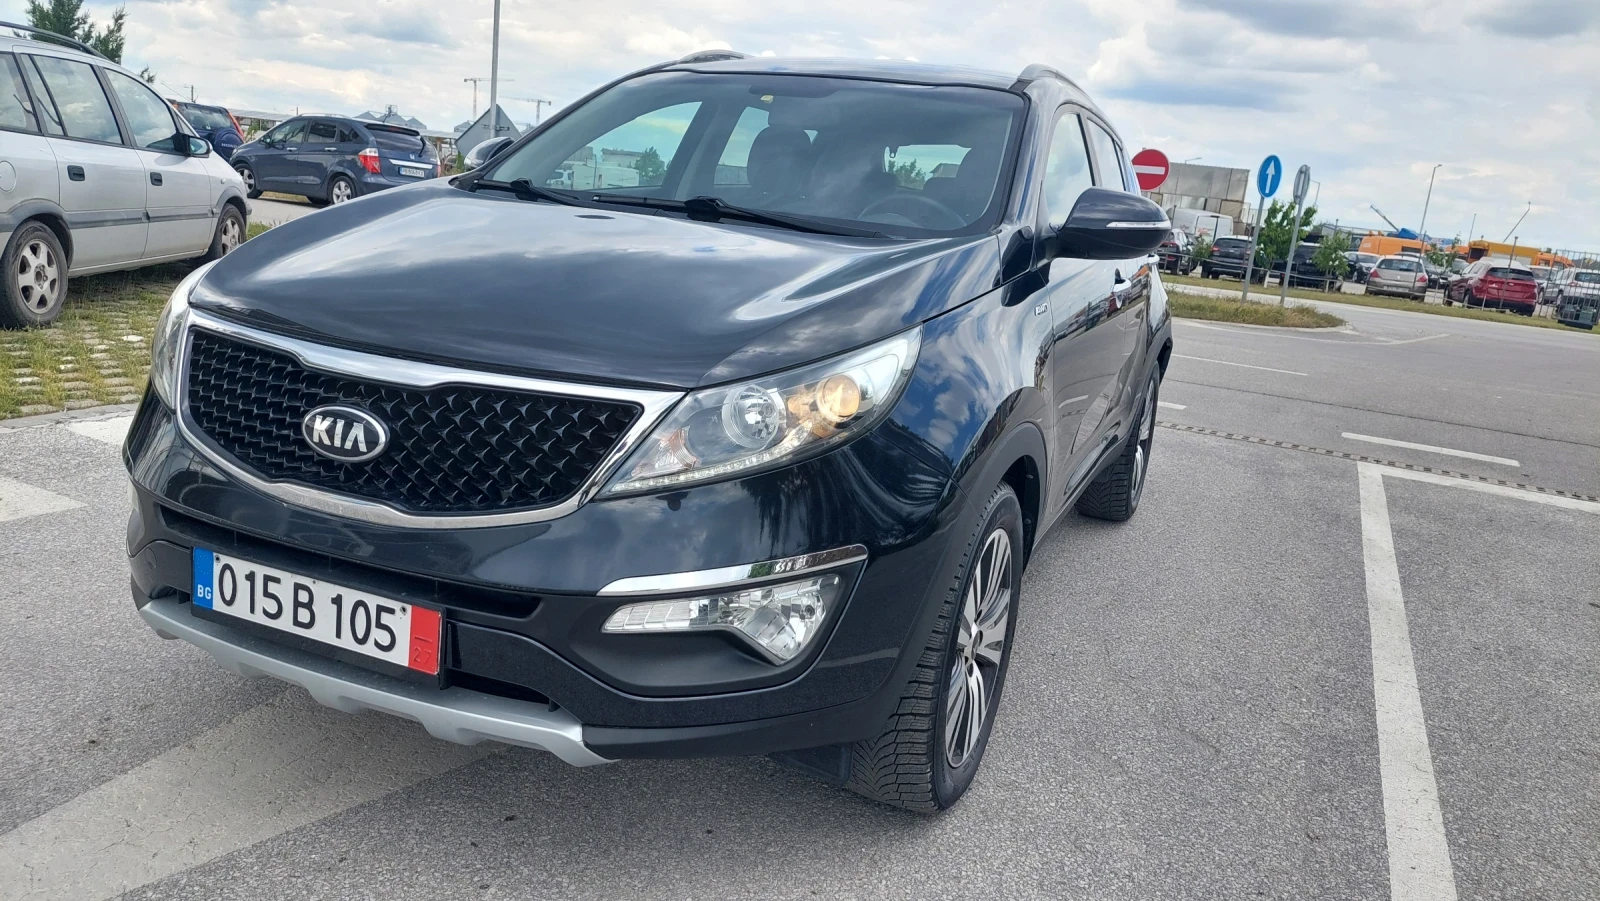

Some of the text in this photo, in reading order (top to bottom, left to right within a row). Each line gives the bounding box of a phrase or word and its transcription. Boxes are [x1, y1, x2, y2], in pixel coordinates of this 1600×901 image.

[312, 414, 368, 453] KIA
[197, 583, 212, 600] BG
[218, 562, 397, 652] 015 B 105
